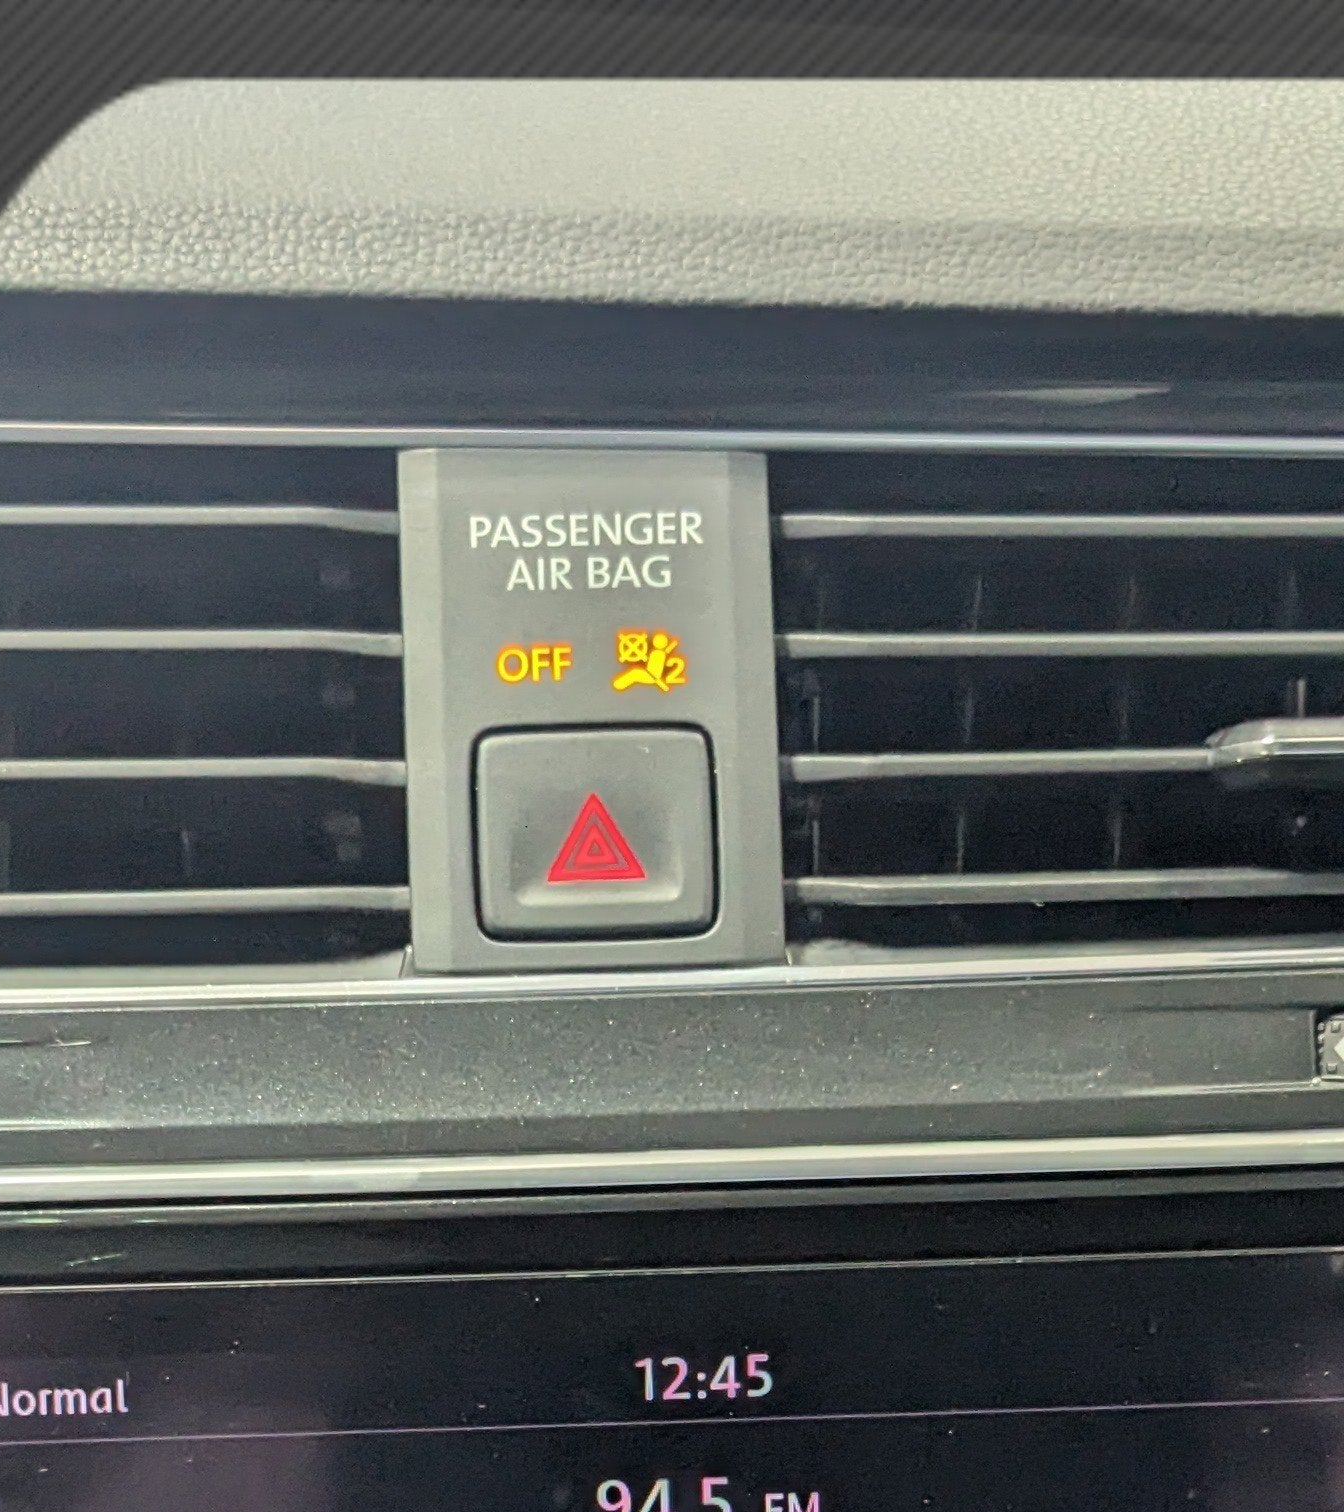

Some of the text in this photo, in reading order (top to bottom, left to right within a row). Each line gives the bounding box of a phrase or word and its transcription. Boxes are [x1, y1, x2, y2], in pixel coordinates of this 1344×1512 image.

[469, 511, 704, 549] PASSENGER
[506, 554, 672, 592] AIR BAG
[494, 642, 573, 685] OFF
[634, 1352, 774, 1402] 12:45
